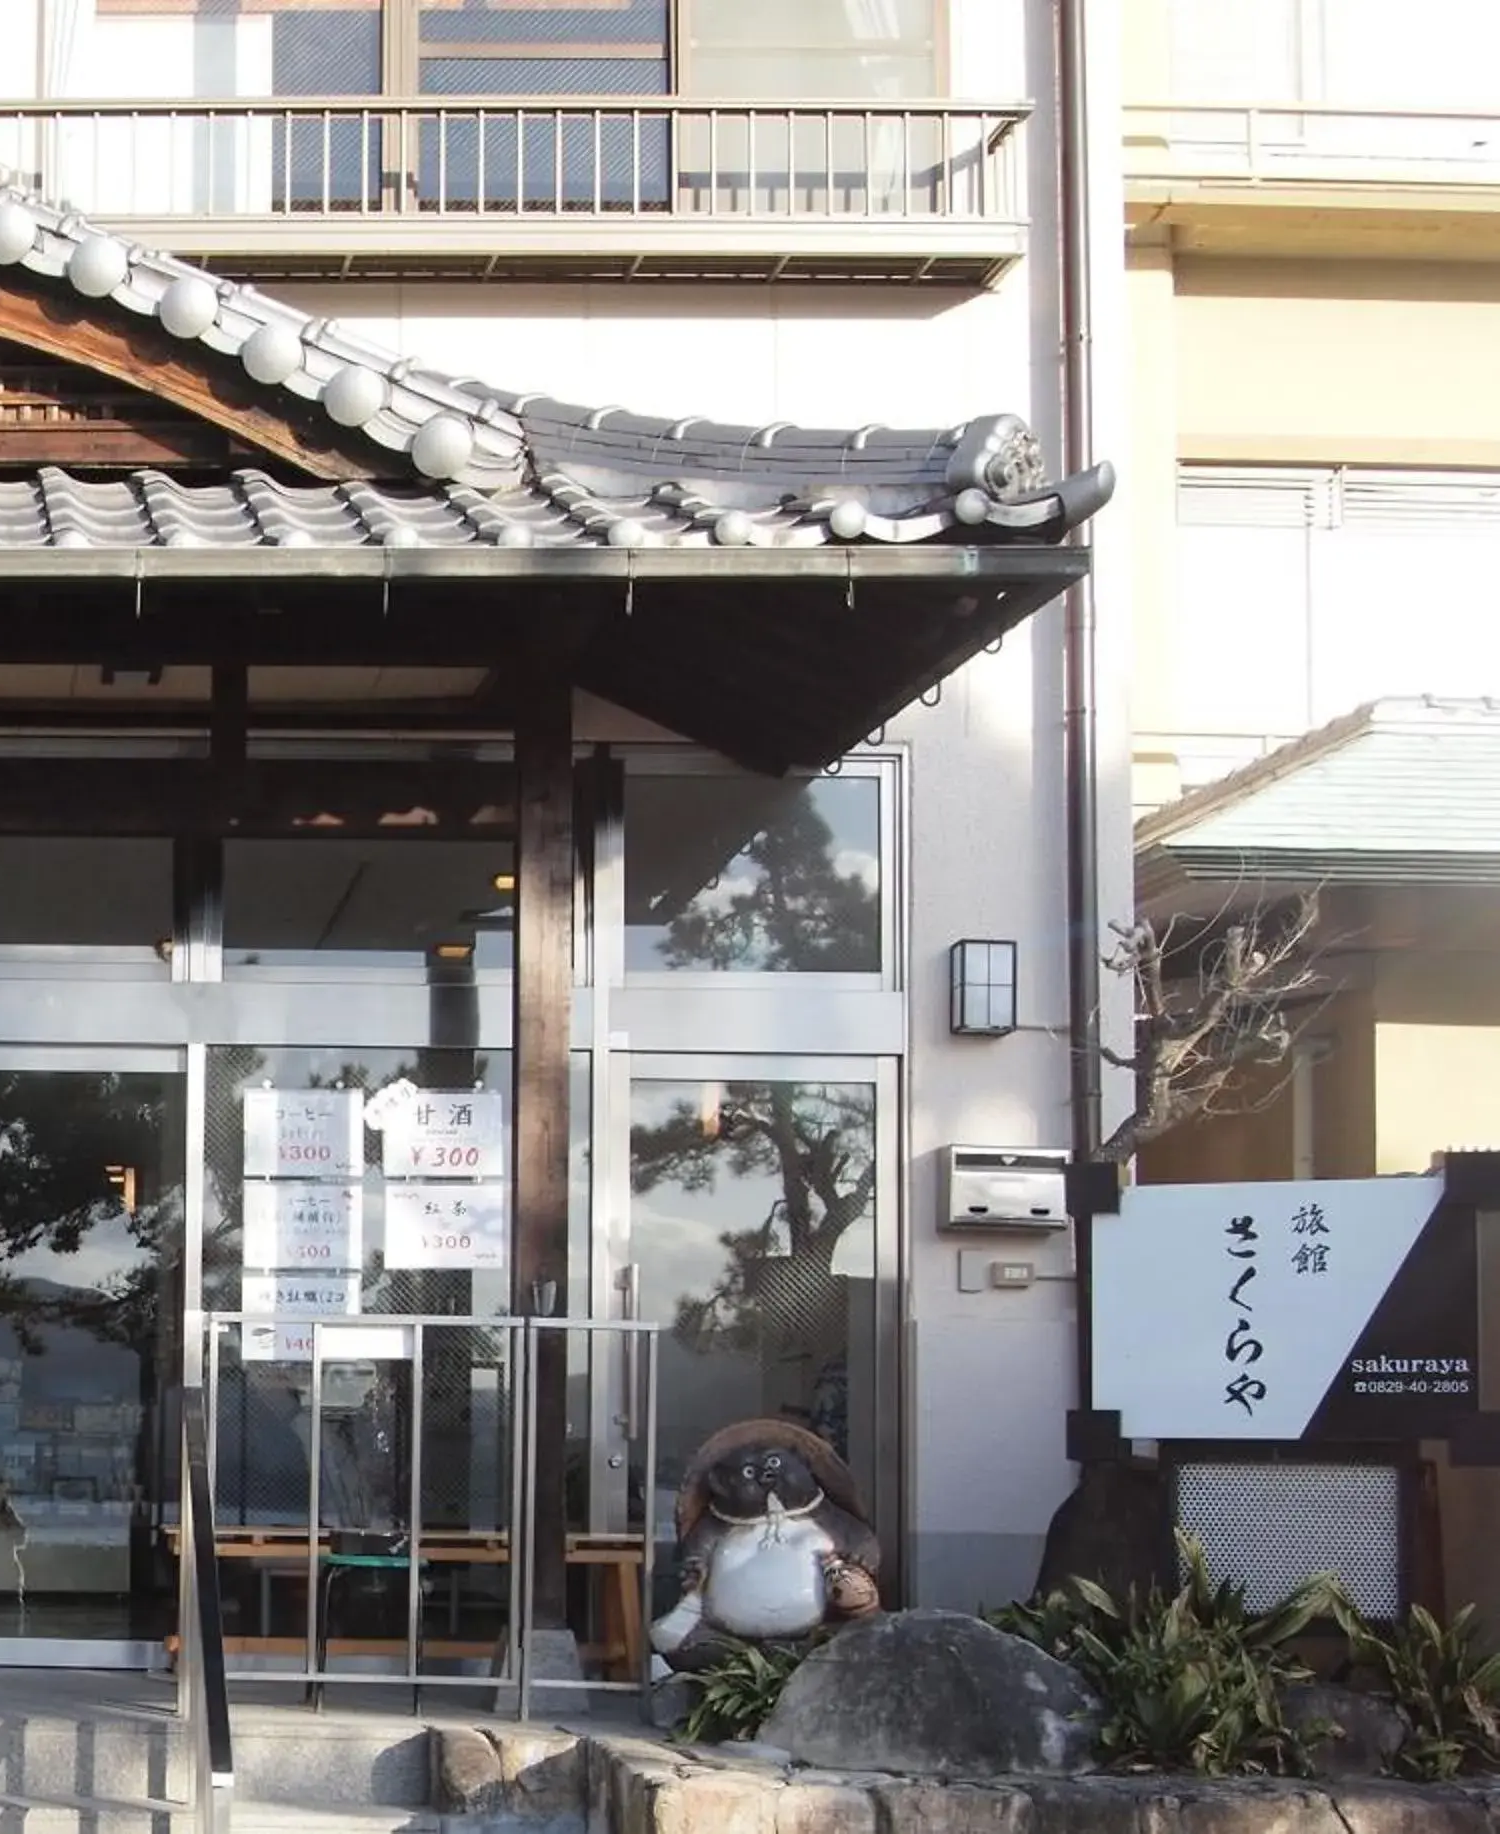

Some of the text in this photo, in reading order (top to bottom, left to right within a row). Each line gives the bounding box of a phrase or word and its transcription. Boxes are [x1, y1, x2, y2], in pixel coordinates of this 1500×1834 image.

[416, 1103, 473, 1127] 甘酒
[1290, 1203, 1331, 1274] 旅館
[1223, 1215, 1267, 1416] さくらや
[1351, 1354, 1470, 1375] sakuraya
